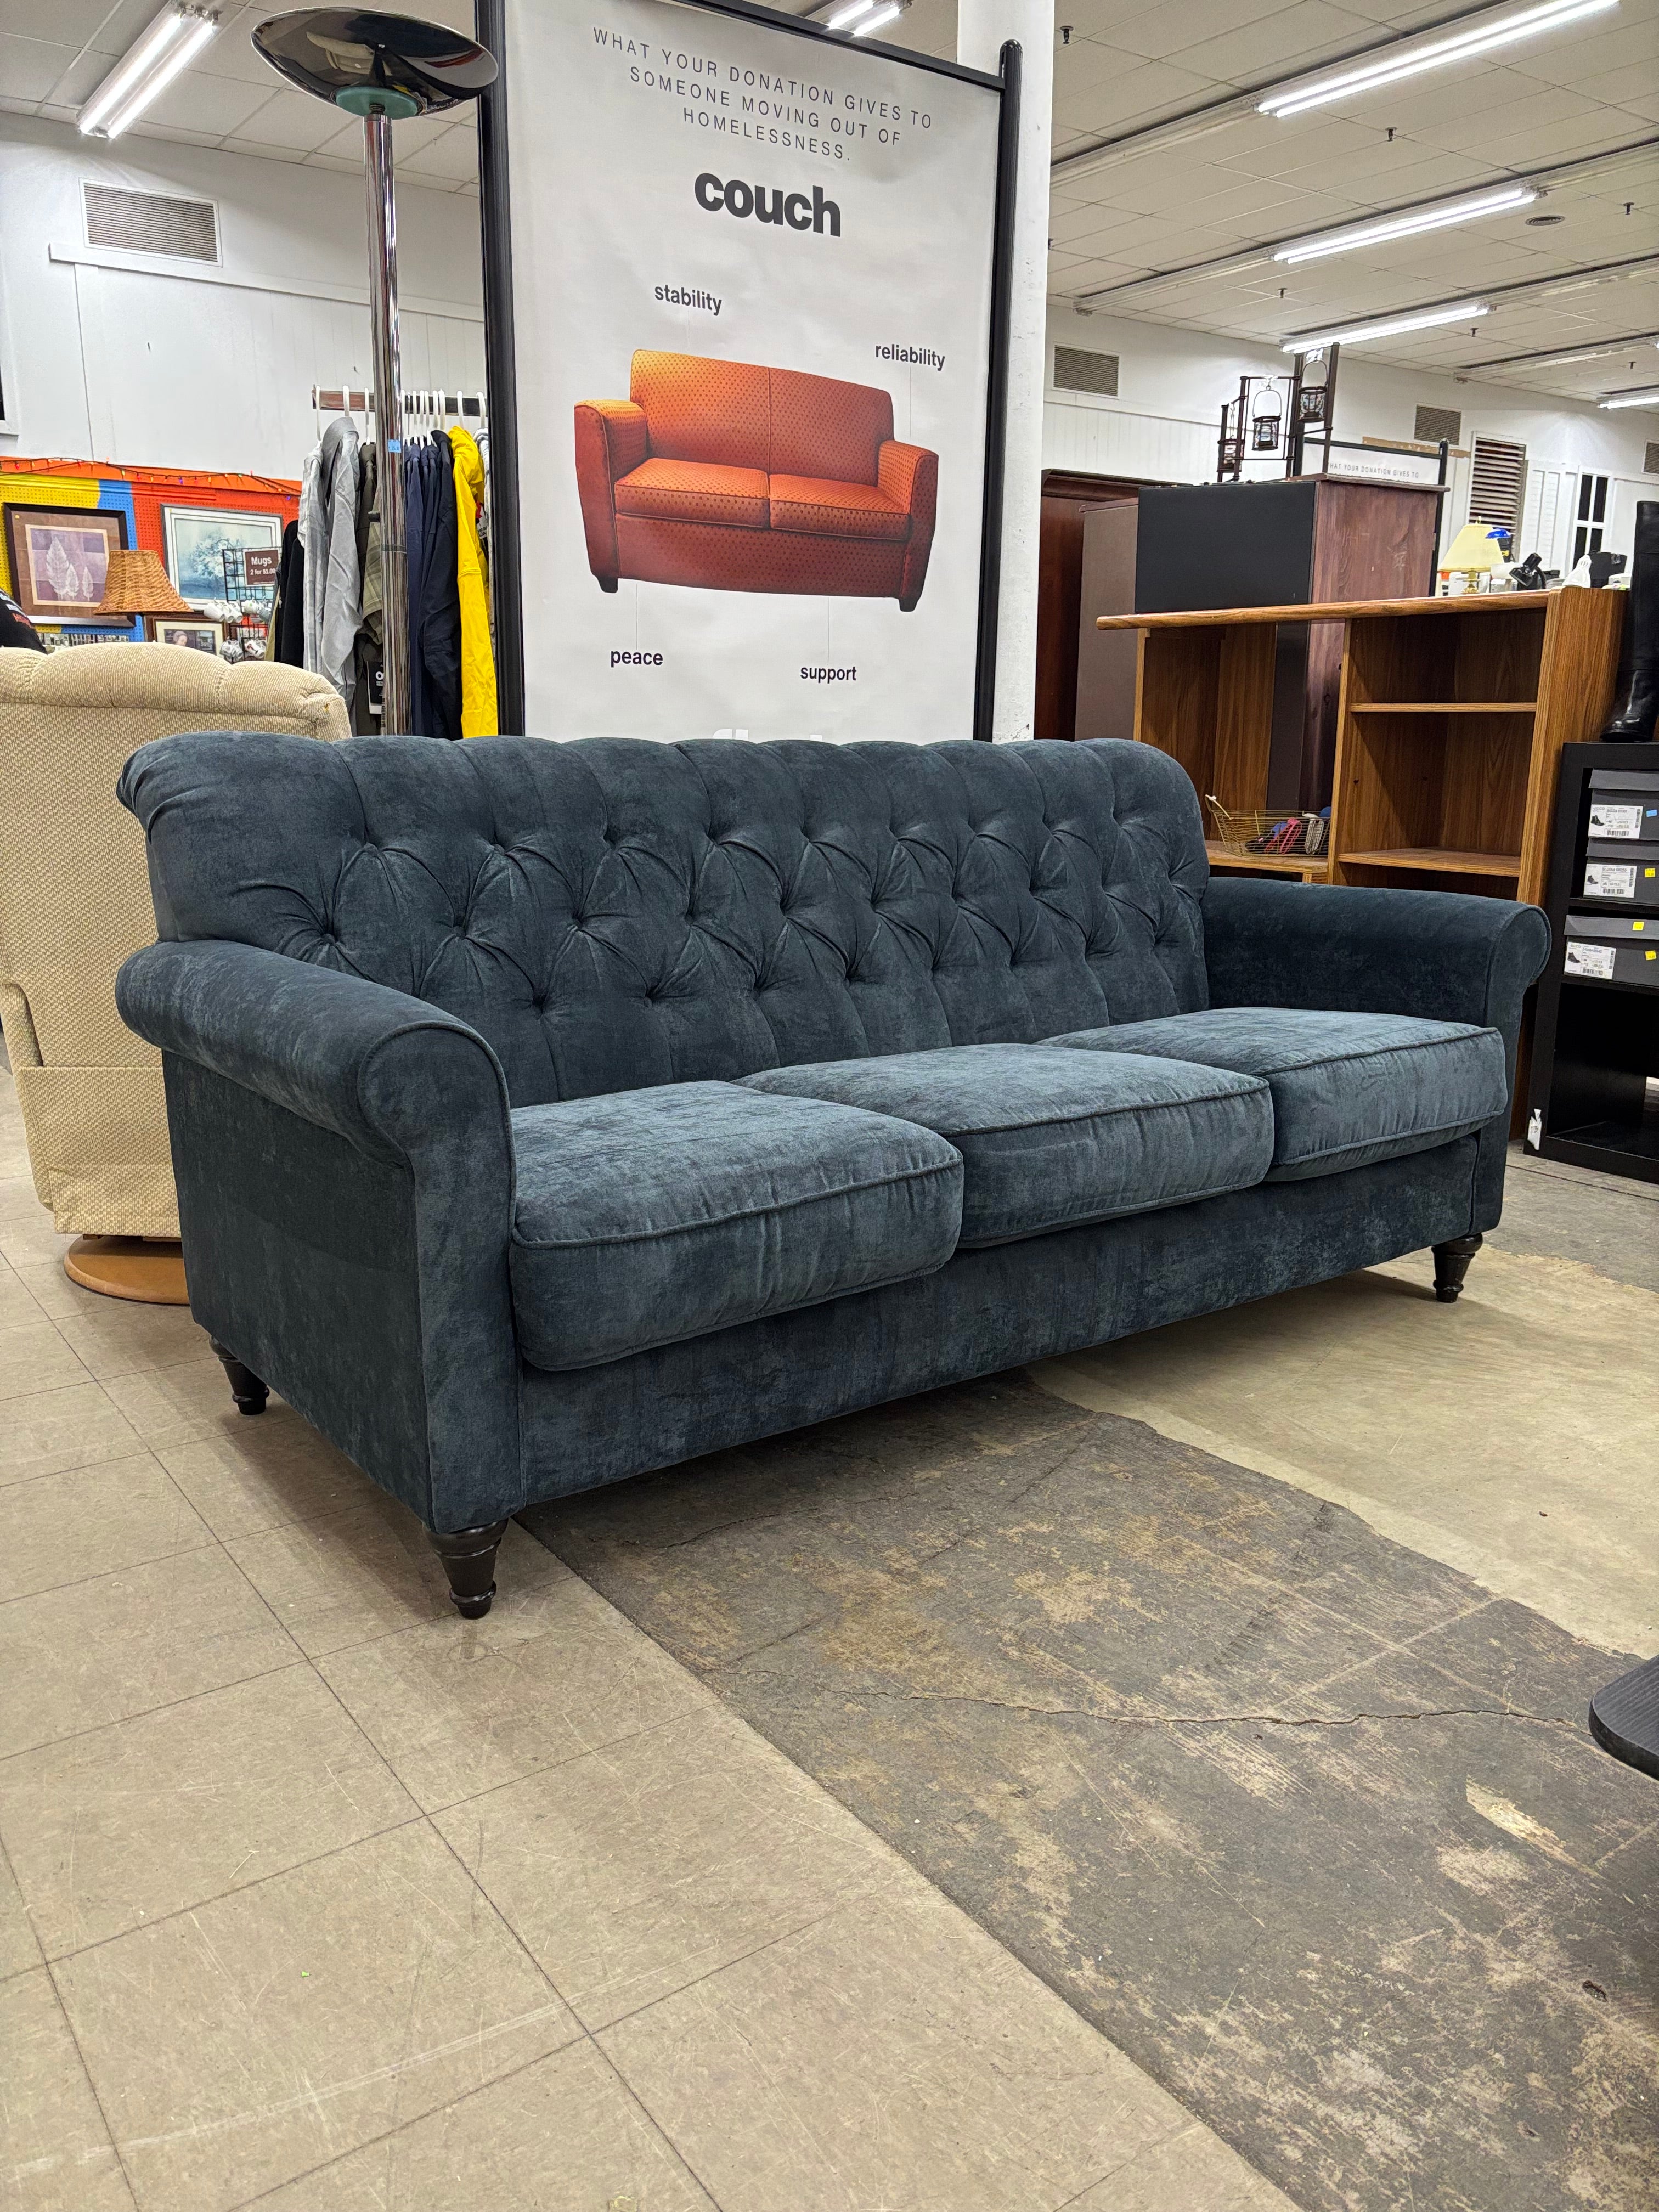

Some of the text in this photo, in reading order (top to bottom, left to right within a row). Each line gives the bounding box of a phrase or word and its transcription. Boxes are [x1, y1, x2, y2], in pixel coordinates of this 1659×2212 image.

[593, 27, 932, 129] WHAT YOUR DONATION GIVES TO
[630, 66, 901, 145] SOMEONE MOVING OUT OF
[684, 107, 851, 162] HOMELESSNESS.
[694, 172, 842, 238] couch
[654, 284, 723, 317] stability
[875, 343, 946, 371] reliability
[1361, 466, 1391, 475] DONATION
[251, 556, 272, 567] Mugs
[610, 650, 664, 668] peace
[800, 666, 857, 684] support
